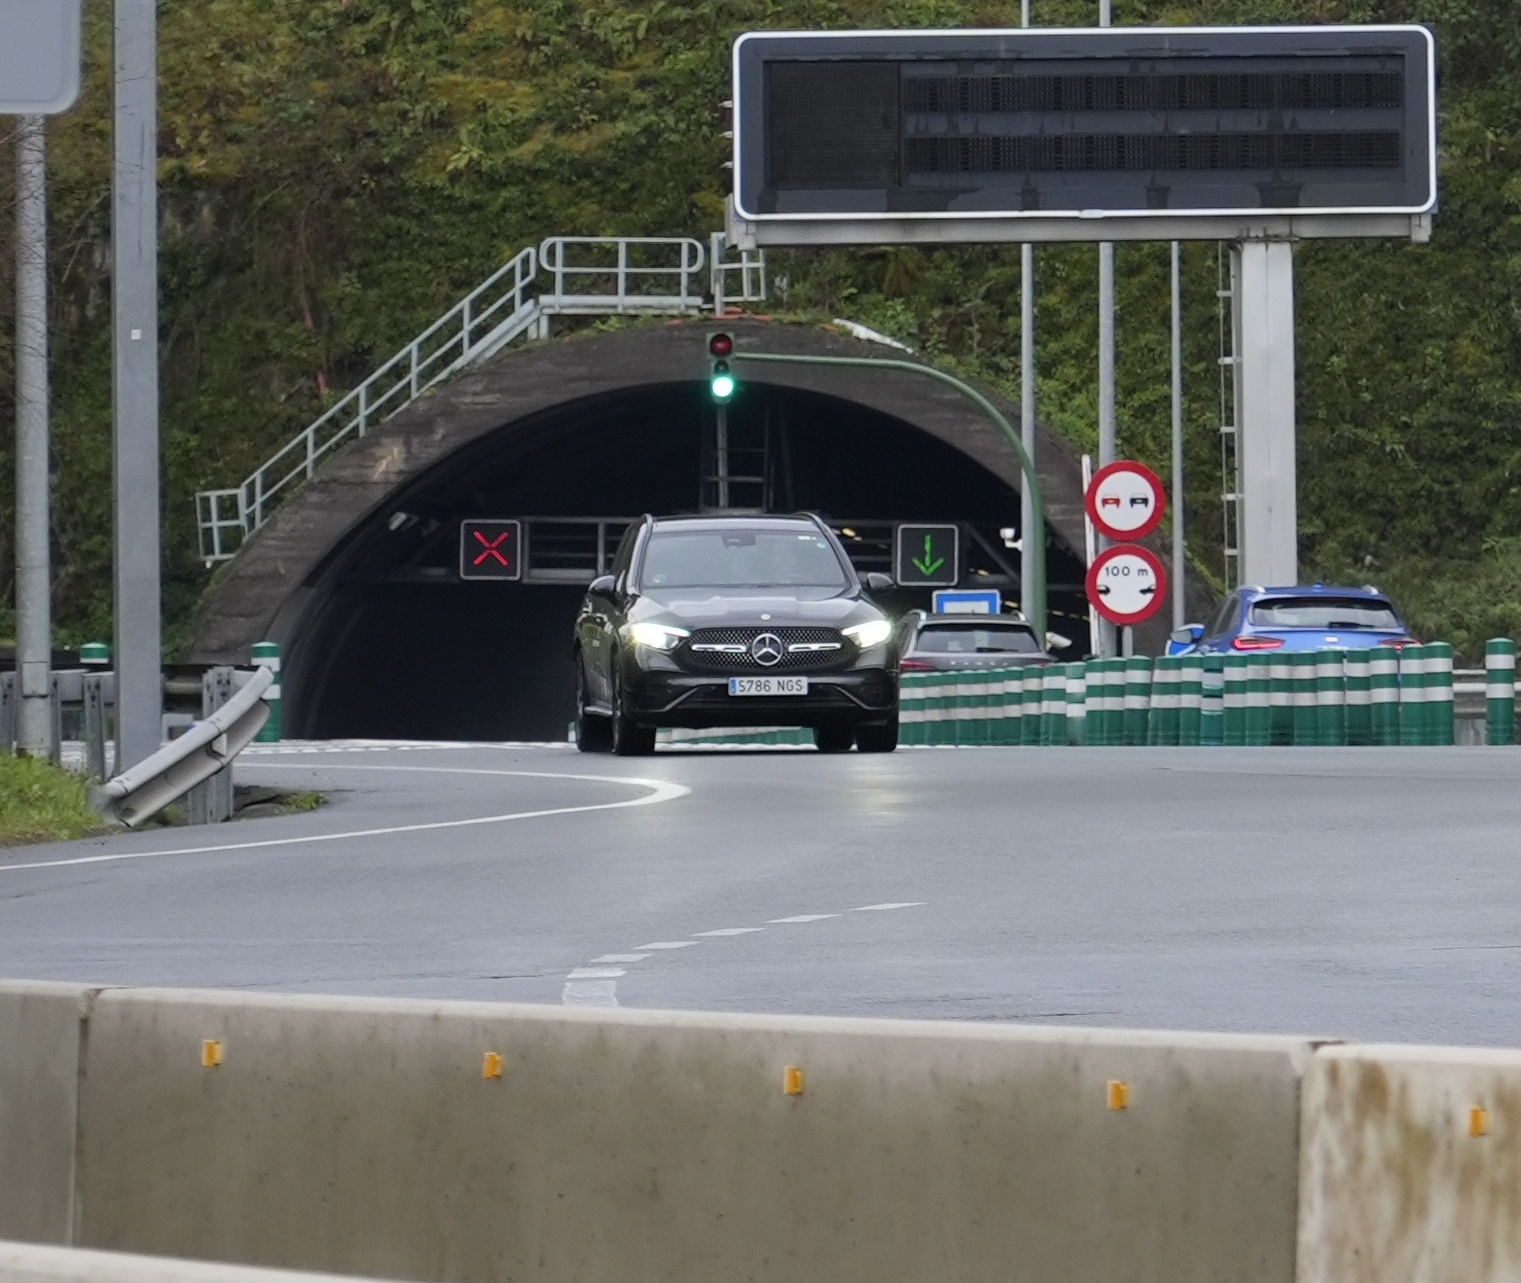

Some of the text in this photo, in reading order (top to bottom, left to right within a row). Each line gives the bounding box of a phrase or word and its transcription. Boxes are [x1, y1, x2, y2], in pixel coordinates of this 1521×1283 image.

[1105, 566, 1149, 577] 100 m
[738, 679, 803, 693] 5786 NGS
